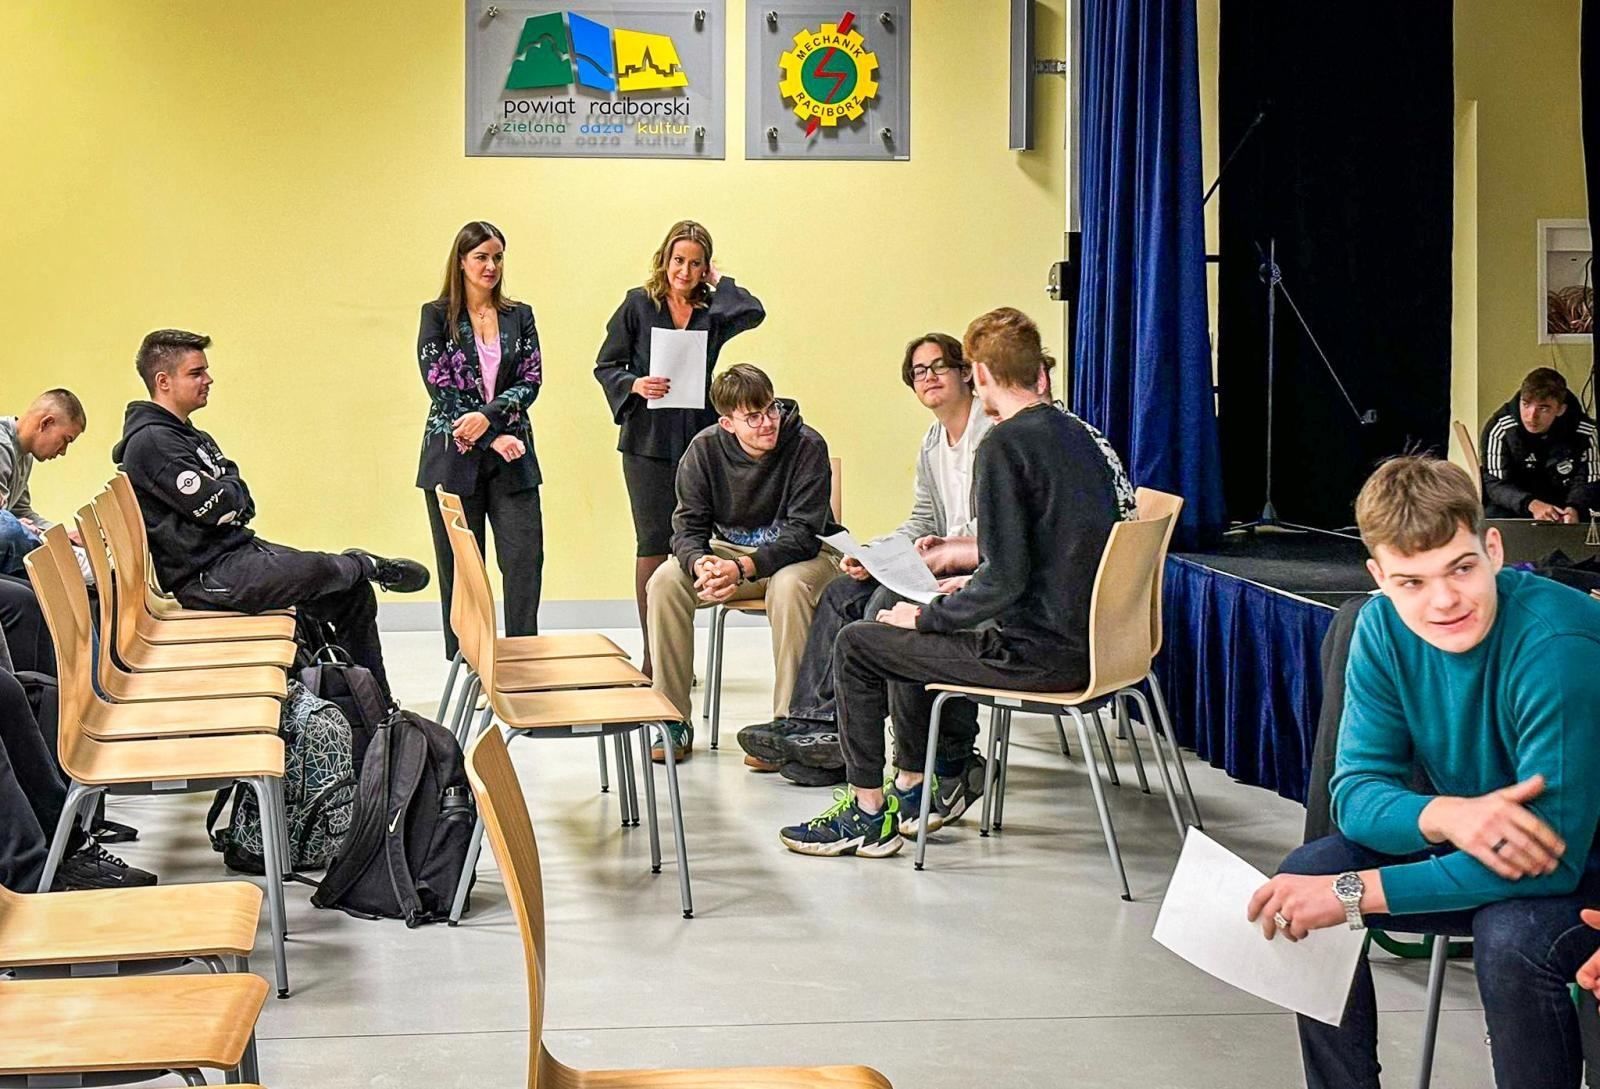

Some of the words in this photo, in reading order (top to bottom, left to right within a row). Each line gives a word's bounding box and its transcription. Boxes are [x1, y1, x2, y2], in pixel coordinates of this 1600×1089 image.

[796, 35, 863, 60] MECHANIK
[504, 95, 577, 119] powiat
[590, 96, 690, 116] raciborski
[795, 92, 862, 117] RACIBÓRZ
[503, 121, 566, 134] zielona
[580, 123, 624, 134] oaza
[637, 121, 691, 135] kultur
[192, 488, 225, 518] ミュウツー
